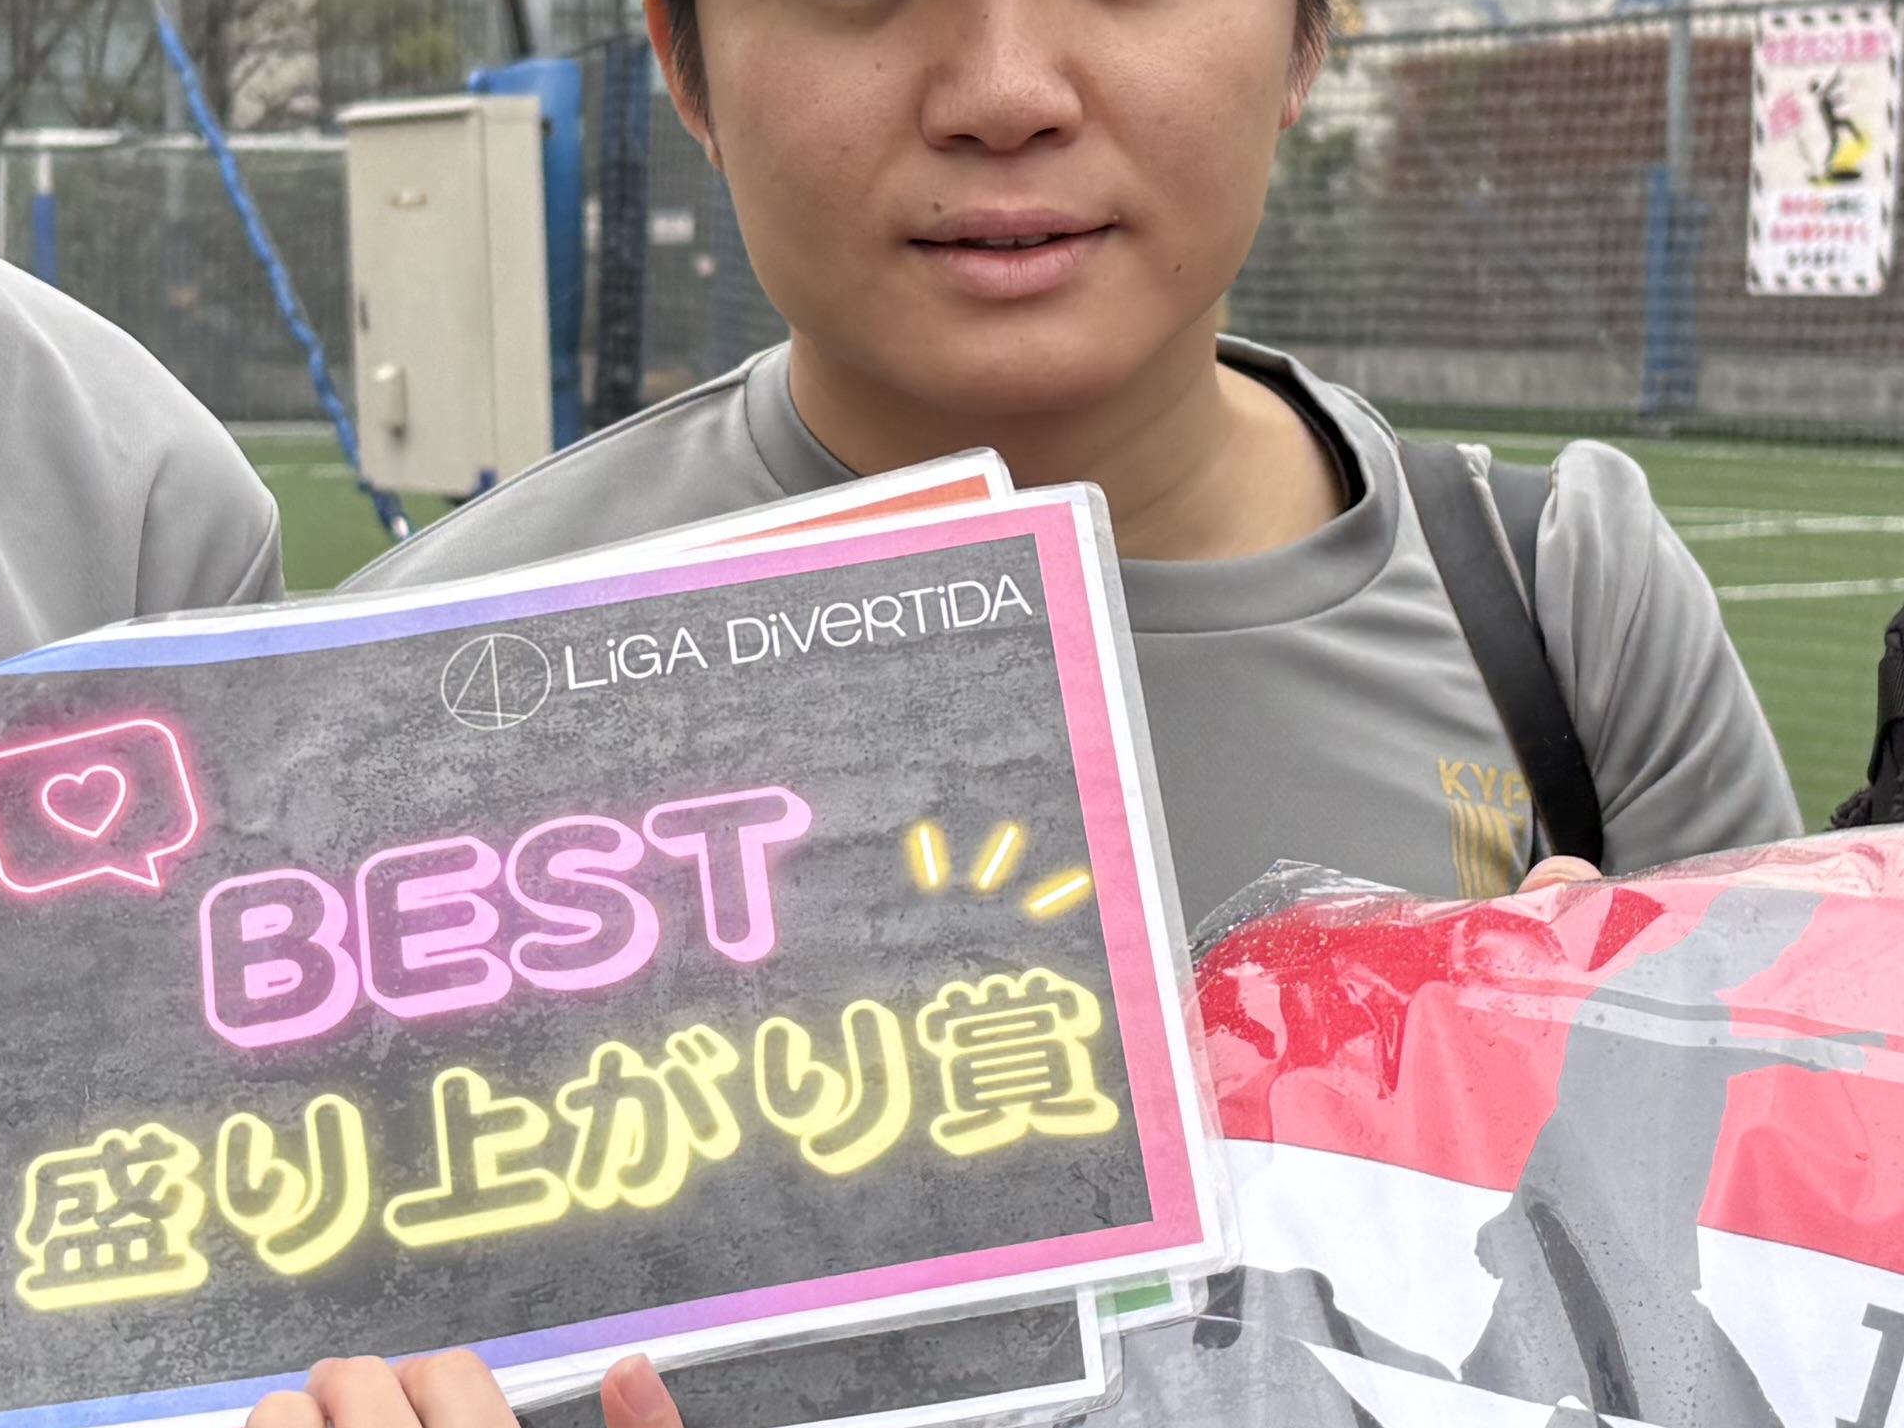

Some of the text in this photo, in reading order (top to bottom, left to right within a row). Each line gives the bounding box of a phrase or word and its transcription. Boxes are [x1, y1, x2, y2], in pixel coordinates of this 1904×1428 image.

[199, 785, 811, 1048] BEST
[16, 968, 1121, 1312] 盛り上がり賞
